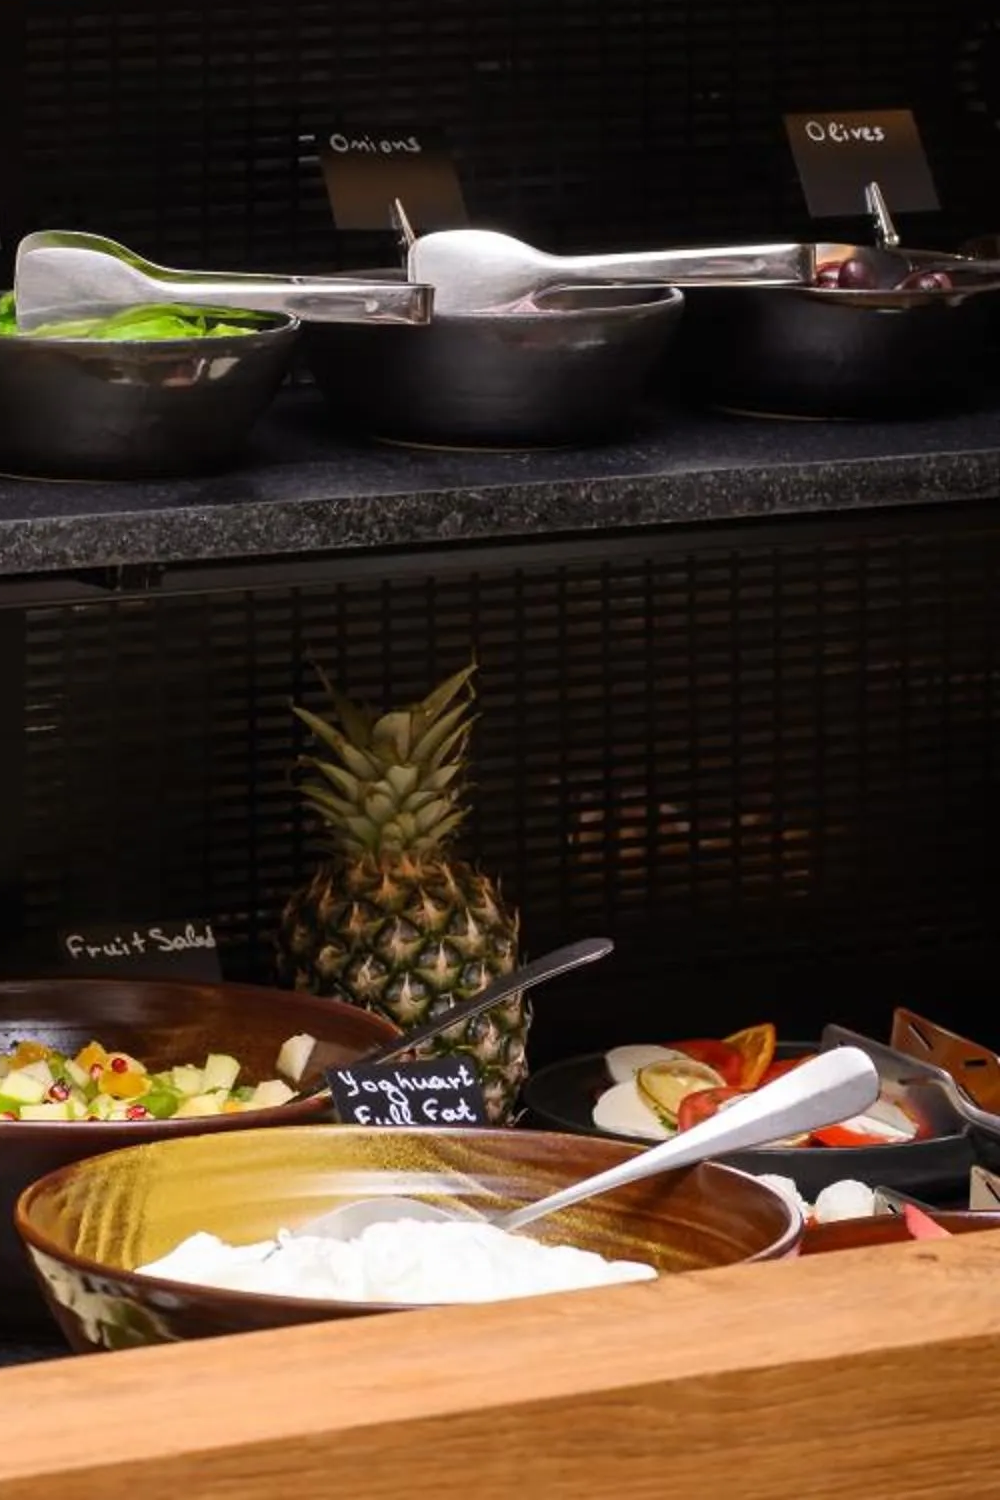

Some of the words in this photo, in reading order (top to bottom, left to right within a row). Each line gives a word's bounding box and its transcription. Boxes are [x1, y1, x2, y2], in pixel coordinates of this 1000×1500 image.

[329, 133, 422, 153] Onions
[805, 120, 886, 143] Olives
[65, 931, 147, 959] Fruit
[421, 1097, 478, 1122] Fat
